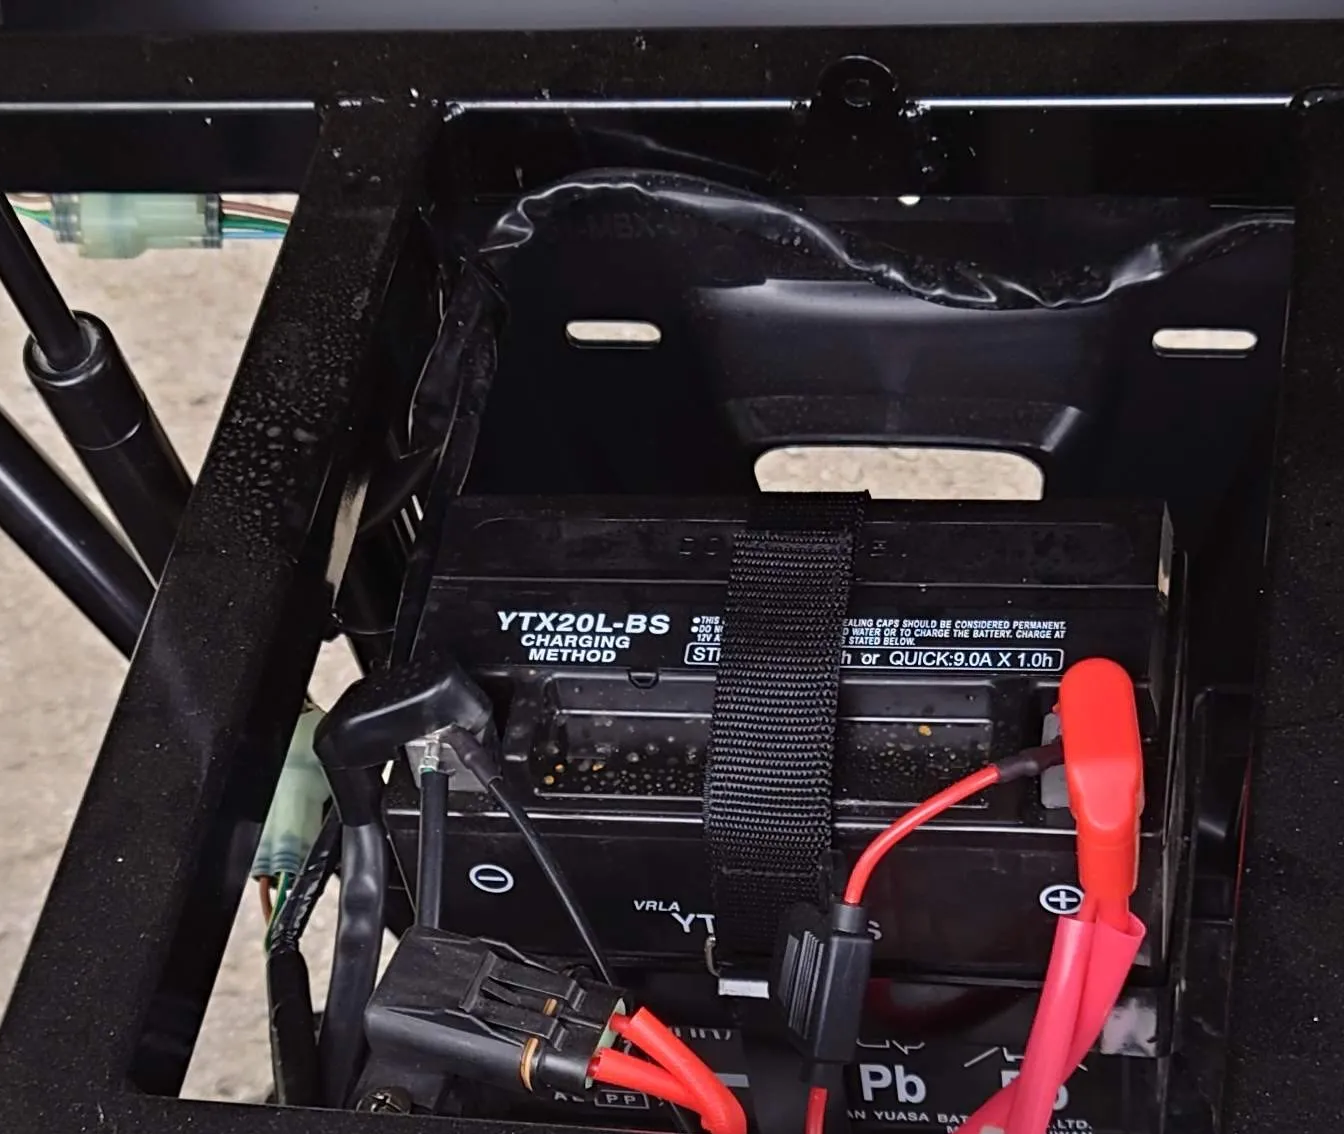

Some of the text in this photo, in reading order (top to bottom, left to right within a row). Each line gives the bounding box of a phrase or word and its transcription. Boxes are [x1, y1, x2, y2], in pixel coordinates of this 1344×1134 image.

[497, 611, 671, 635] YTX20L-BS
[701, 615, 1067, 630] THIS EALING CAPS SHOULD BE CONSIDERED PERMANENT.
[698, 624, 712, 634] DO
[852, 627, 882, 637] WATER
[883, 628, 897, 637] OR
[900, 628, 912, 637] TO
[913, 628, 951, 638] CHARGE
[953, 629, 970, 638] THE
[972, 629, 1013, 639] BATTERY.
[1015, 630, 1053, 639] CHARGE
[1053, 630, 1067, 639] AT
[520, 634, 631, 649] CHARGING
[697, 633, 713, 642] 12V
[848, 636, 881, 645] STATED
[883, 636, 916, 646] BELOW.
[528, 648, 617, 663] METHOD
[861, 652, 881, 666] or
[889, 650, 993, 667] QUICK:9.0A
[996, 651, 1013, 667] X
[1017, 651, 1053, 668] 1.0h
[634, 899, 681, 913] VRLA
[859, 1063, 927, 1104] Pb
[605, 1093, 637, 1105] PP
[873, 1110, 930, 1122] YUASA
[937, 1112, 970, 1125] BAT
